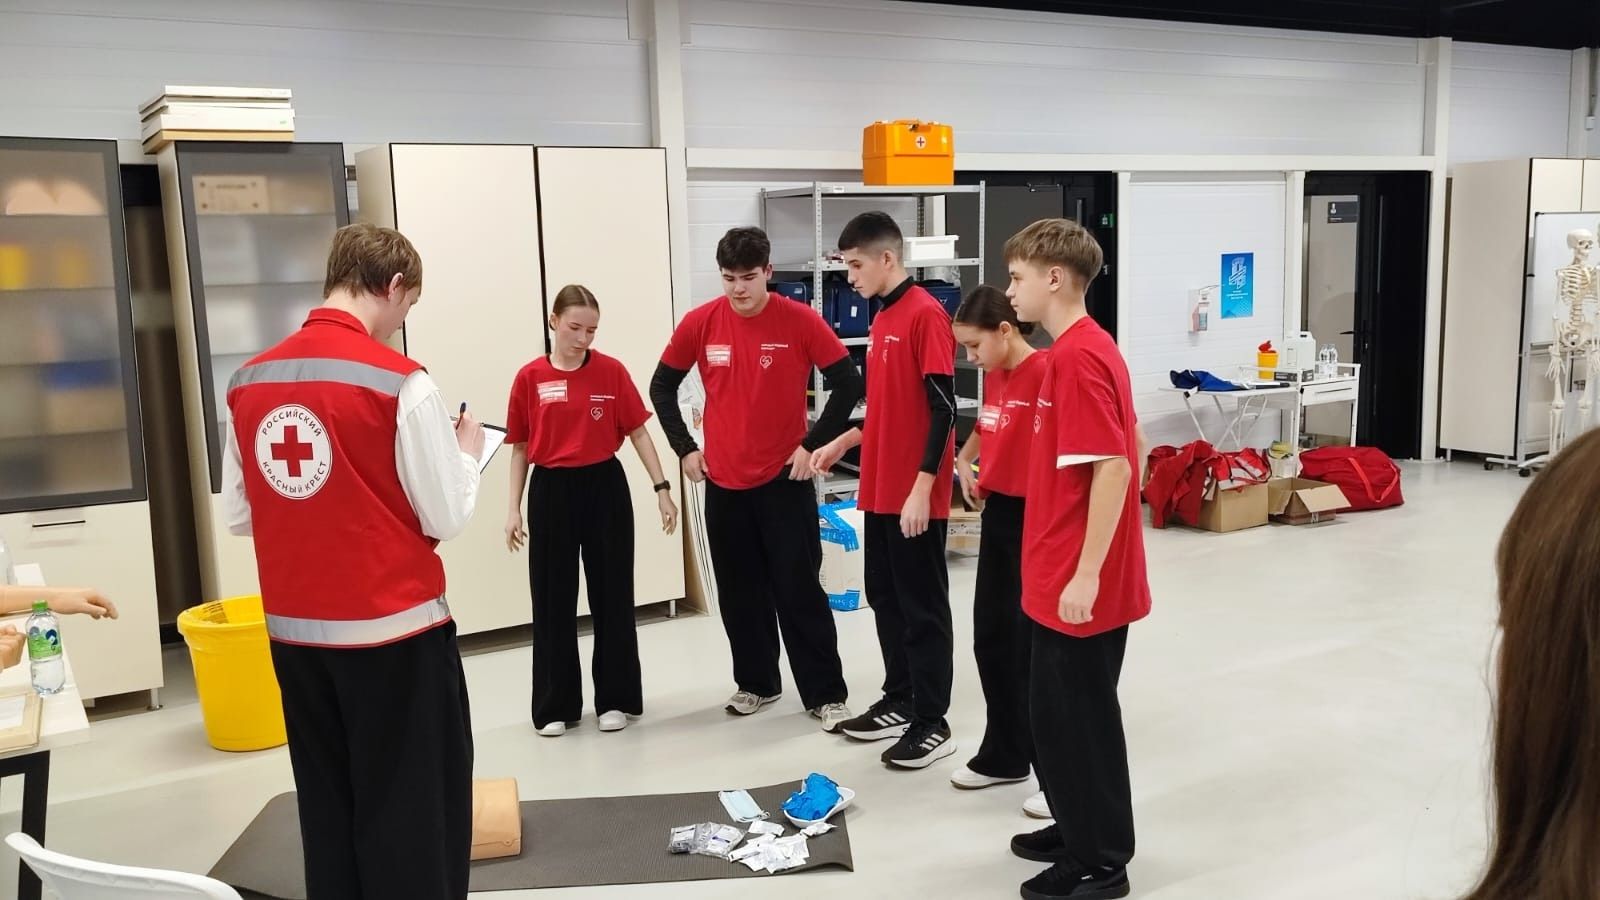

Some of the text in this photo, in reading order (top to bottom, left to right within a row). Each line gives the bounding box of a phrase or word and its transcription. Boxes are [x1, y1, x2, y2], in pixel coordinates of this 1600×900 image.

[262, 409, 322, 437] РОССИЙСКИЙ
[263, 460, 327, 493] КРАСНЫЙ КРЕСТ
